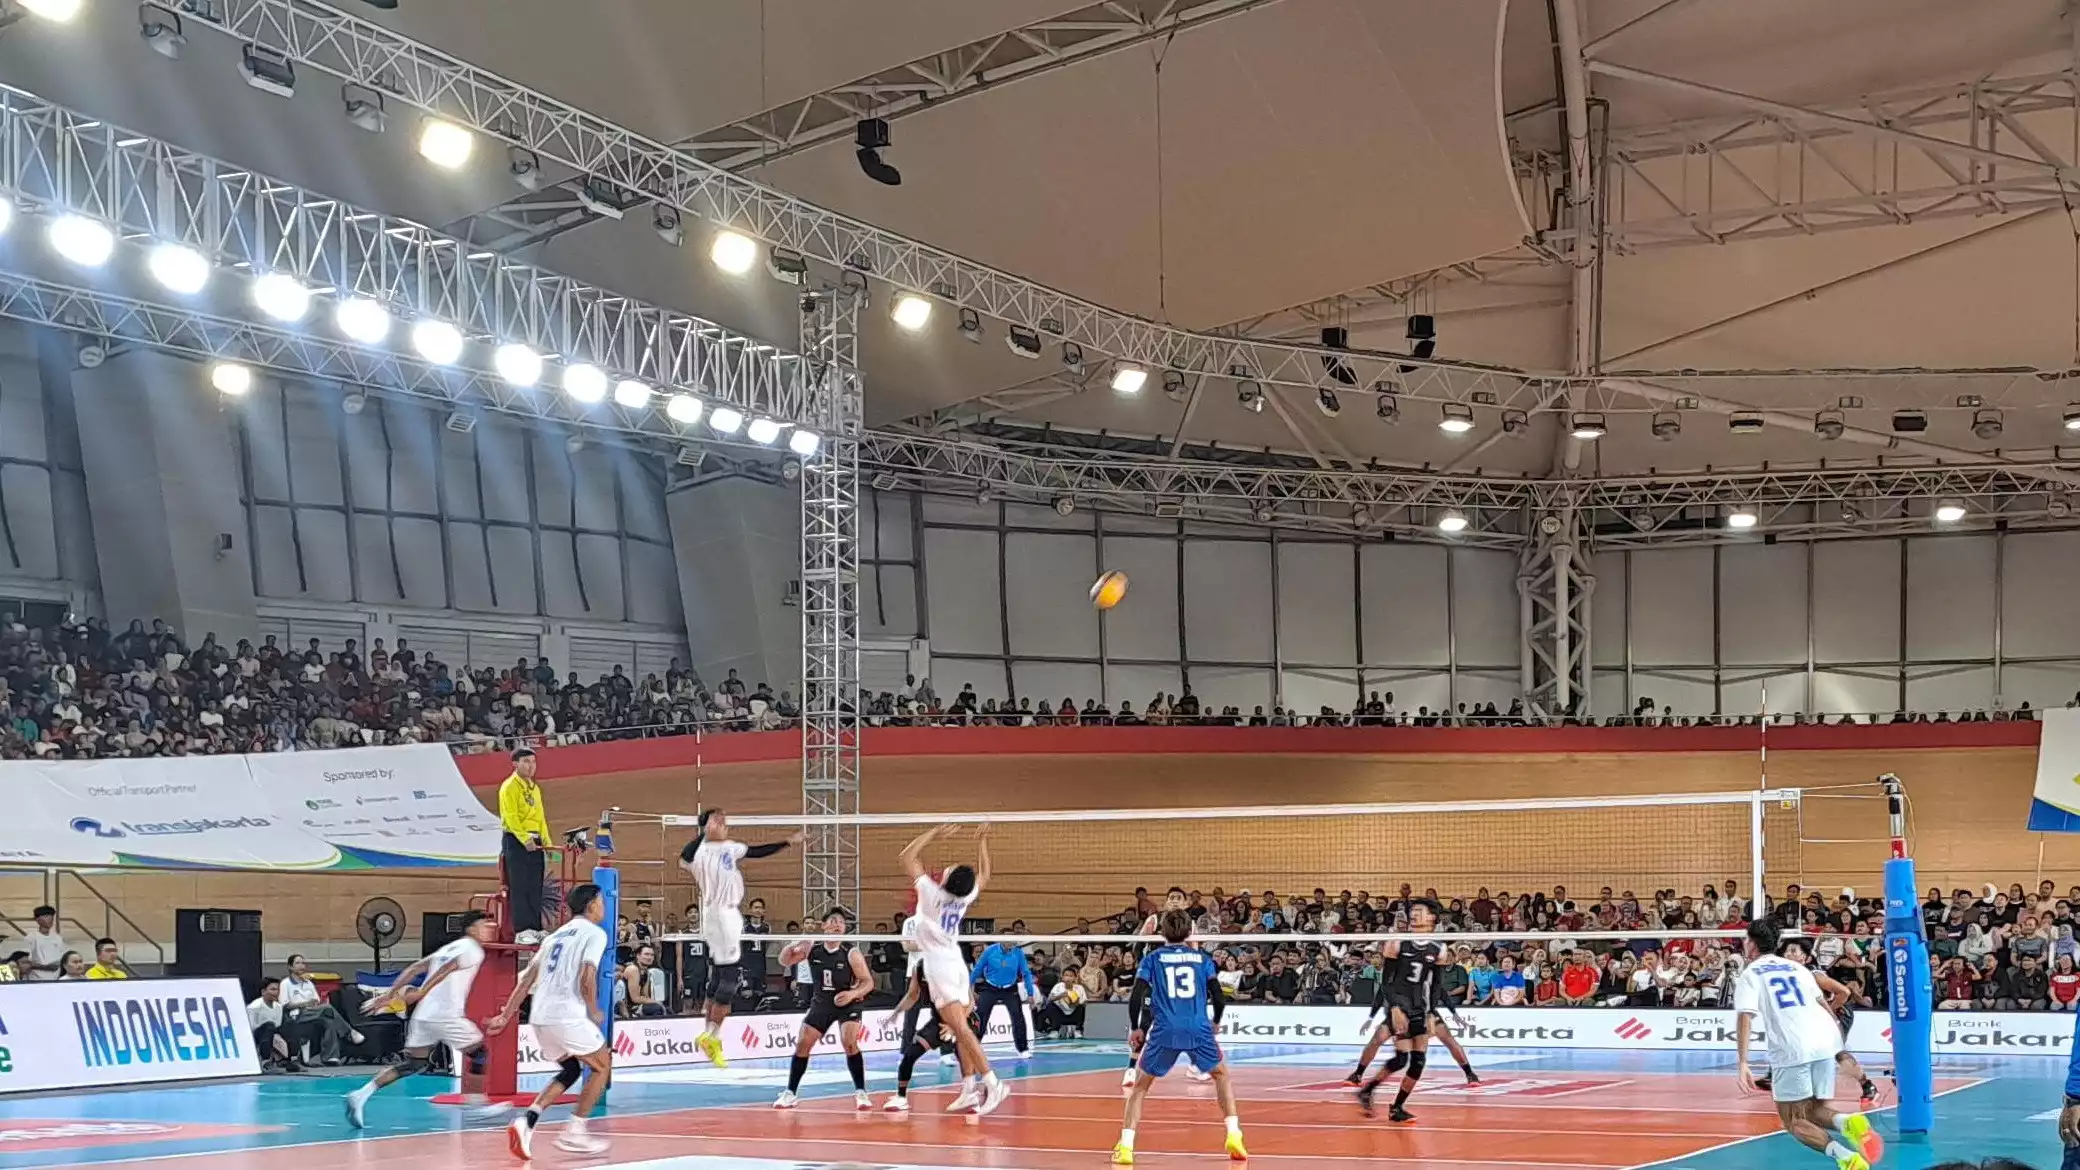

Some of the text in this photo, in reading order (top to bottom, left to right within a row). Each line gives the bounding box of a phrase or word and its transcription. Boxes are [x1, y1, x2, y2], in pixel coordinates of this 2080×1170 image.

[547, 943, 563, 973] 9
[1407, 961, 1423, 983] 3
[1165, 966, 1196, 999] 13
[1769, 976, 1806, 1009] 21
[767, 1022, 790, 1031] Bank
[1675, 1016, 1725, 1025] Bank
[1948, 1020, 2001, 1028] Bank
[72, 996, 240, 1067] INDONESIA
[644, 1027, 671, 1037] Bank
[1448, 1025, 1574, 1039] akarta
[1663, 1027, 1766, 1042] Jaka
[1934, 1030, 2075, 1047] Jakar
[641, 1038, 698, 1056] Jaka
